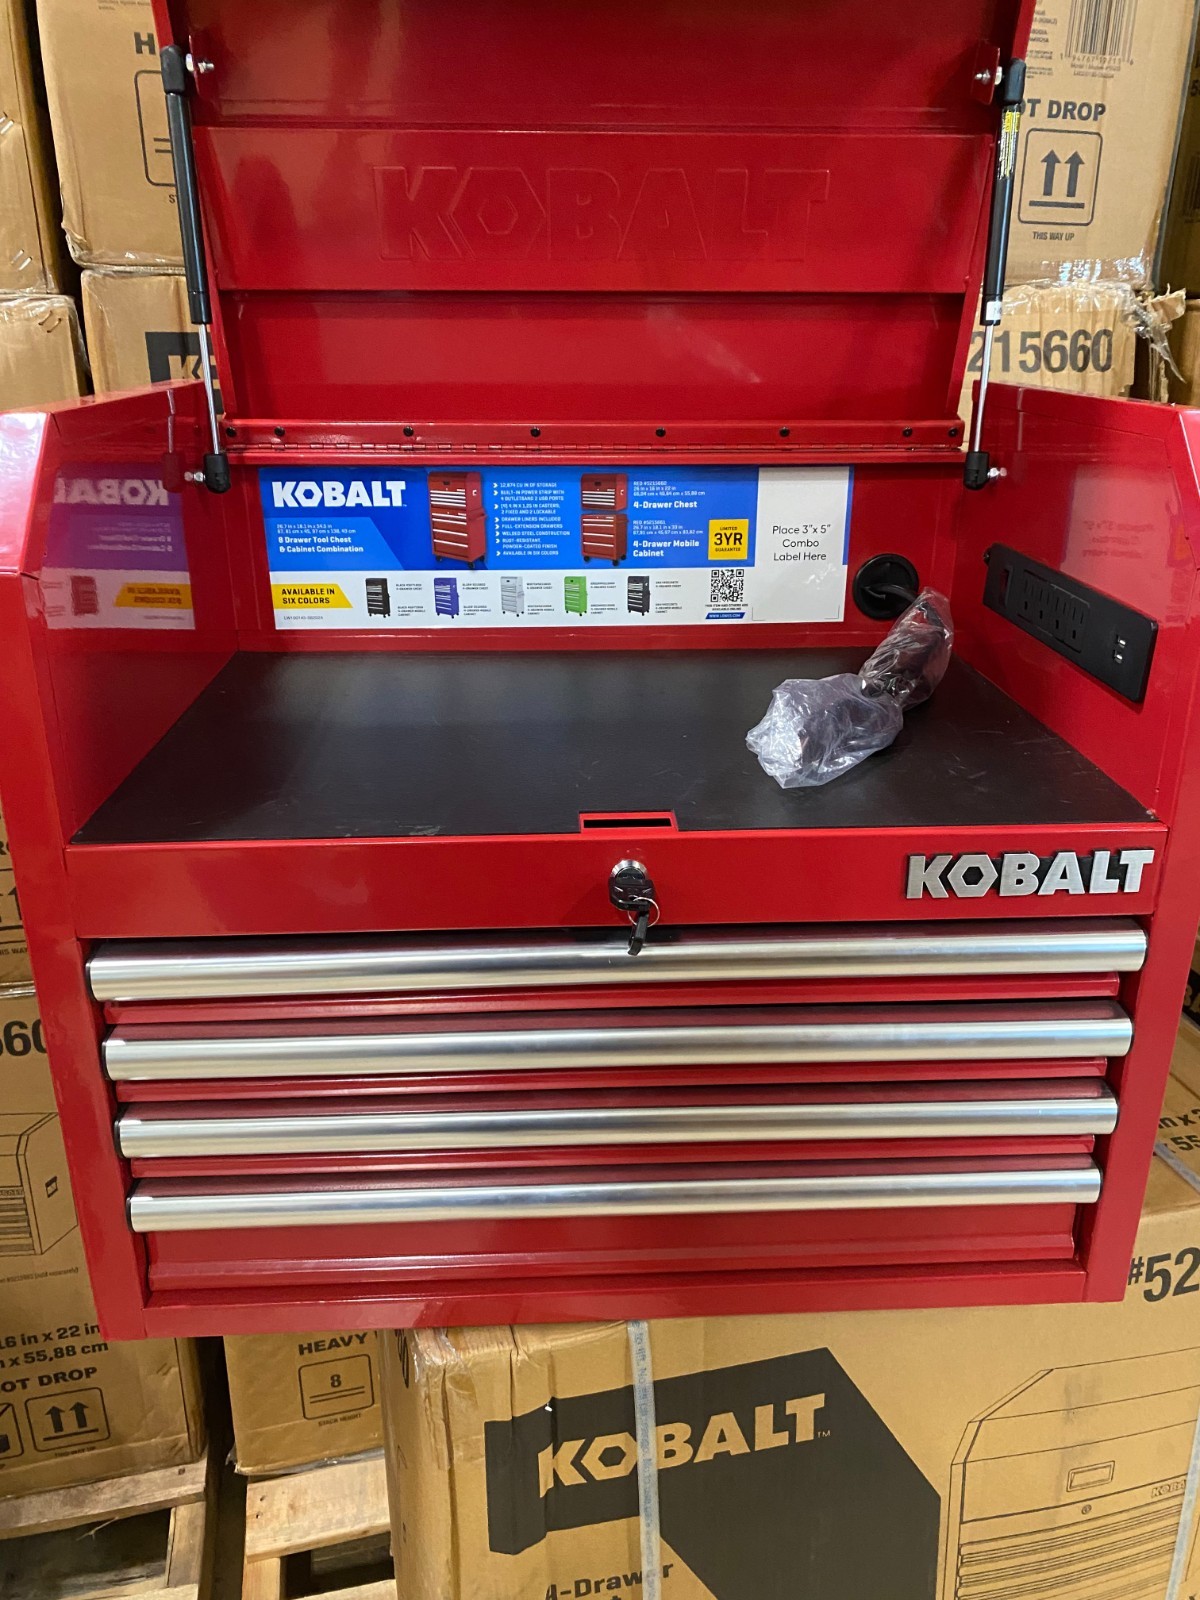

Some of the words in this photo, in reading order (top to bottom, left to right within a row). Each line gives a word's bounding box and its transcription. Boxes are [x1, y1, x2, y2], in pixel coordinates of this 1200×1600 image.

[1047, 100, 1106, 121] DROP
[373, 166, 830, 261] KOBALT
[1032, 232, 1048, 240] THIS
[1050, 232, 1064, 240] WAY
[1065, 232, 1075, 241] UP
[271, 480, 406, 507] KOBALT
[714, 532, 742, 546] 3YR
[772, 526, 800, 534] Place
[820, 524, 831, 533] 5"
[782, 539, 819, 548] Combo
[774, 552, 800, 561] Label
[804, 552, 826, 560] Here
[905, 849, 1155, 899] KOBALT
[21, 1332, 38, 1345] in
[43, 1332, 53, 1342] x
[57, 1325, 81, 1339] 22
[84, 1323, 100, 1336] in
[298, 1332, 368, 1355] HEAVY
[9, 1357, 20, 1367] x
[24, 1346, 76, 1364] 55,88
[81, 1342, 109, 1354] cm
[38, 1366, 97, 1387] DROP
[330, 1374, 342, 1388] 8
[340, 1413, 361, 1422] HEIGHT
[538, 1392, 826, 1498] KOBALT
[545, 1563, 673, 1600] 4-Drawr
